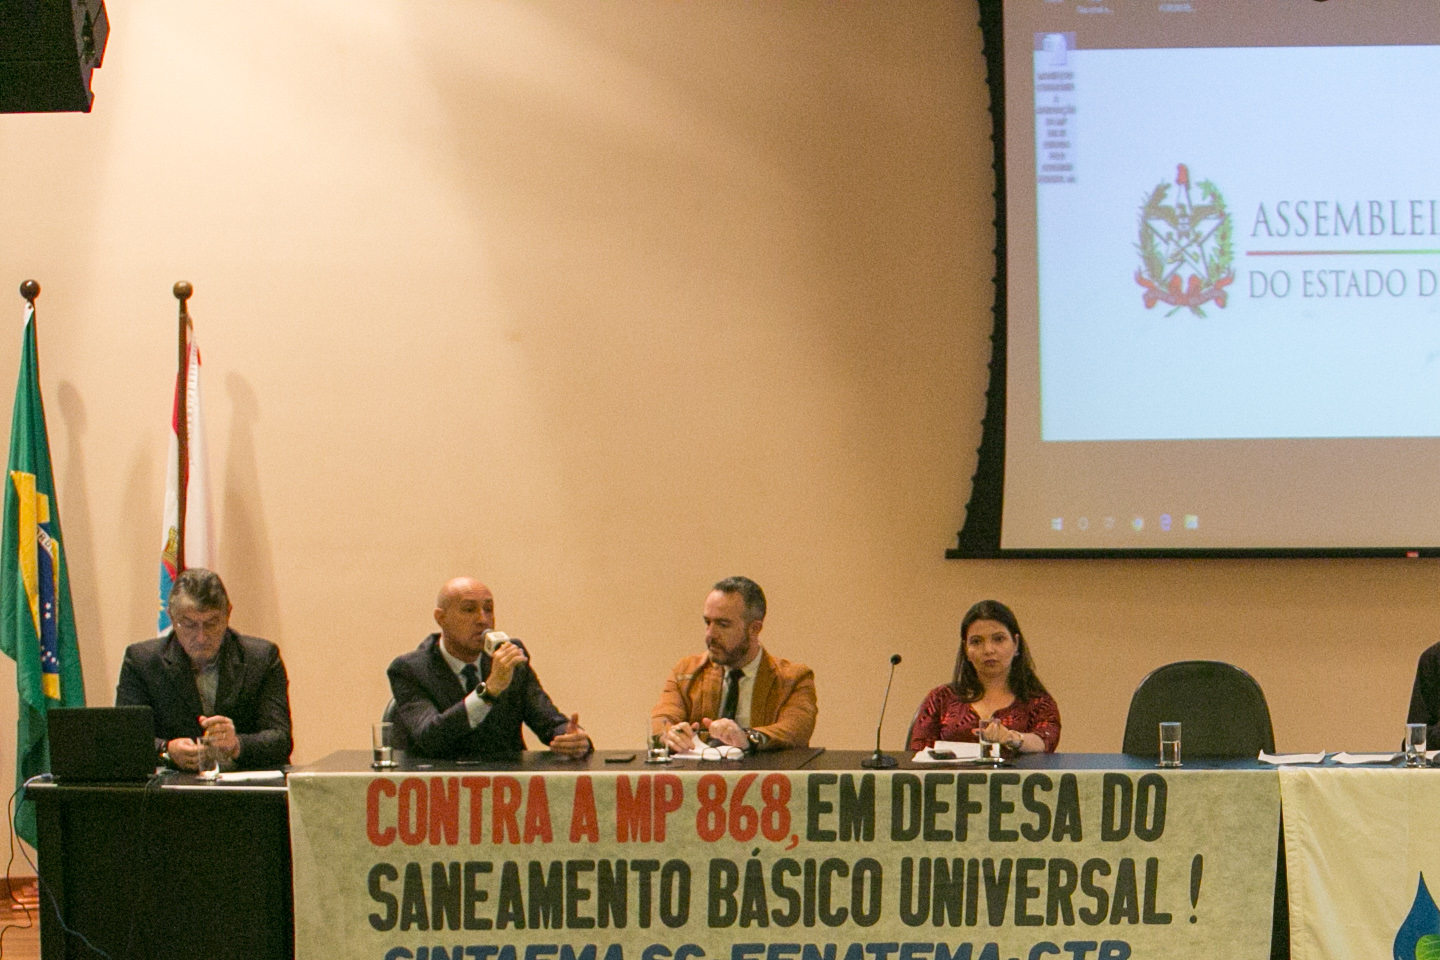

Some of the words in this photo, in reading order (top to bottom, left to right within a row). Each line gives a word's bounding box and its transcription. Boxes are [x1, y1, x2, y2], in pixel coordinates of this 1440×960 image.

[1249, 269, 1291, 298] DO
[1302, 268, 1407, 298] ESTADO
[366, 776, 553, 846] CONTRA
[569, 776, 600, 844] A
[615, 775, 684, 843] MP
[696, 773, 800, 851] 868,
[806, 773, 876, 842] EM
[890, 772, 1084, 843] DEFESA
[1101, 772, 1169, 843] DO
[367, 858, 692, 932] SANEAMENTO
[707, 847, 883, 929] BÁSICO
